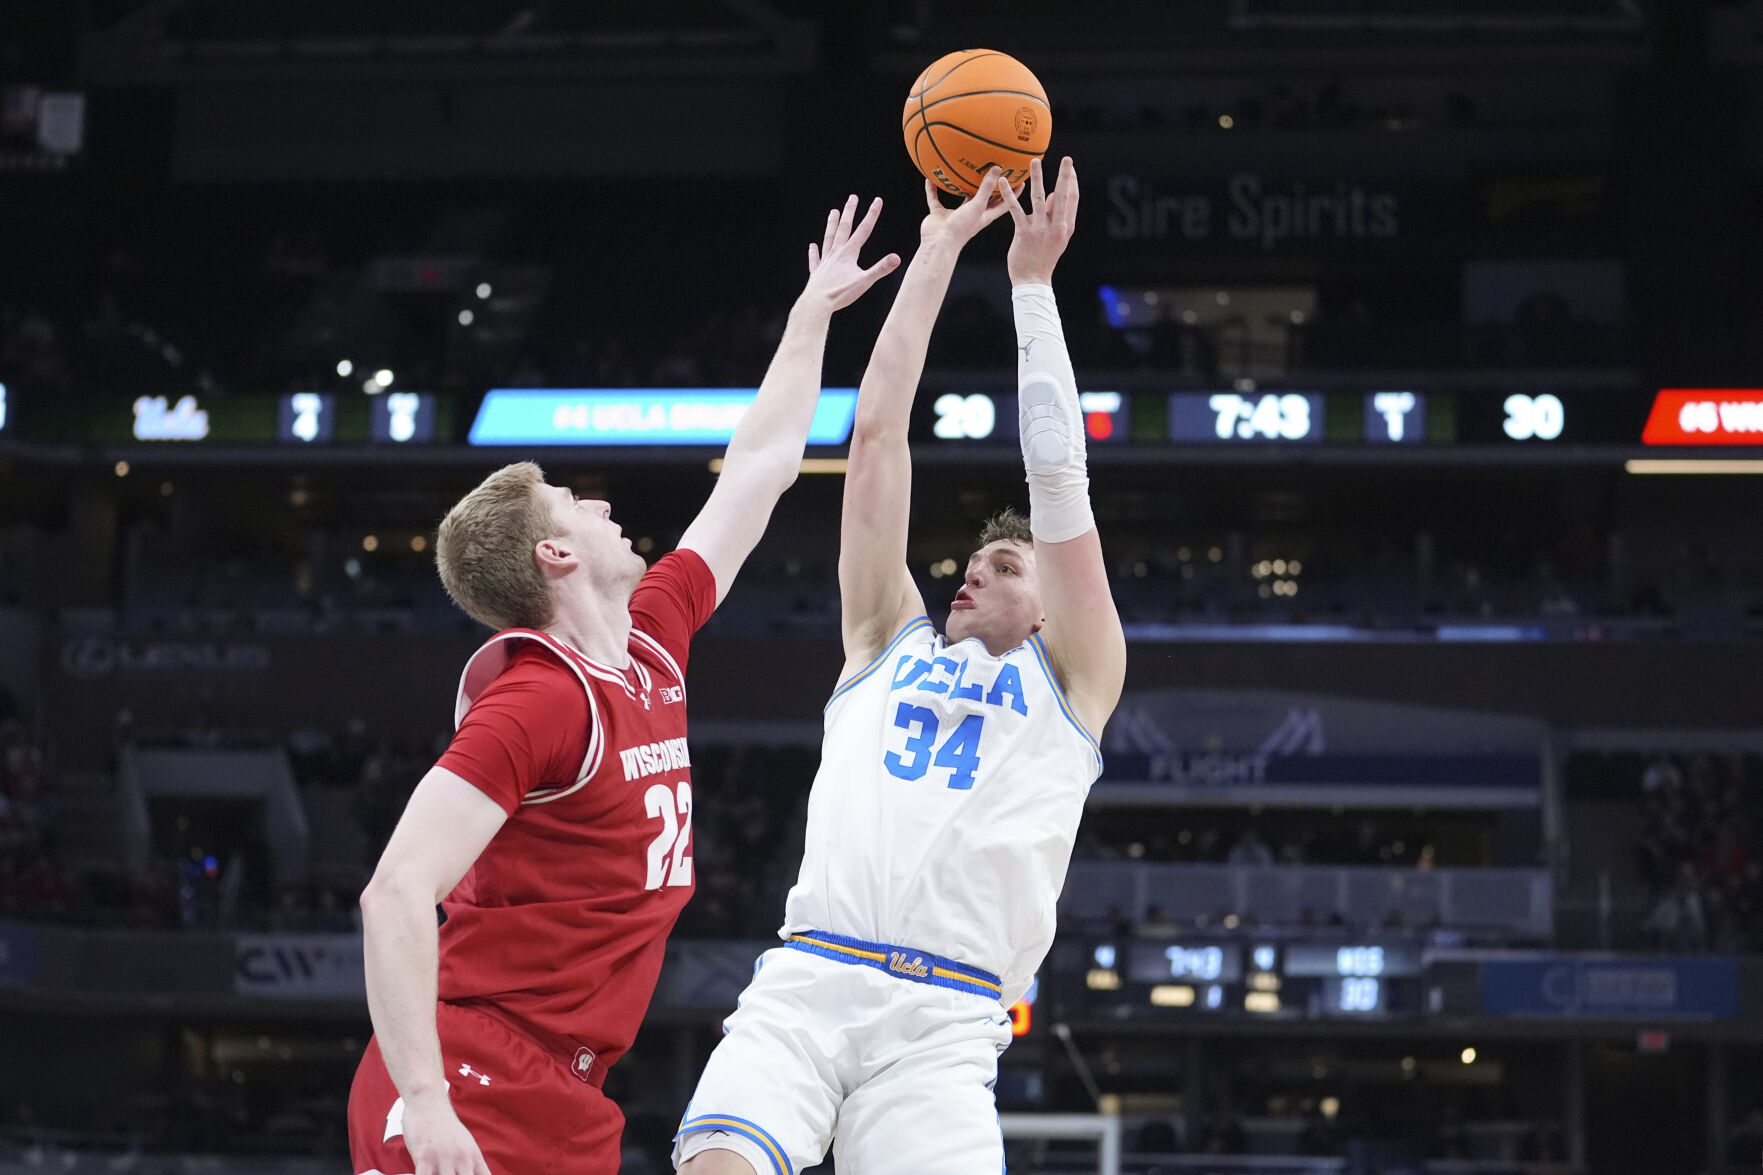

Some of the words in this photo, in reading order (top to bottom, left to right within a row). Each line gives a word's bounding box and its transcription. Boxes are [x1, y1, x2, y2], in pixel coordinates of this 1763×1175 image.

[1106, 173, 1211, 240] Sire
[1228, 172, 1399, 248] Spirits
[934, 393, 996, 439] 20
[1209, 394, 1310, 440] 7:43
[1503, 394, 1564, 439] 30
[891, 654, 1028, 717] UCLA
[884, 702, 985, 790] 34
[644, 781, 692, 890] 22
[889, 951, 928, 977] Ucla
